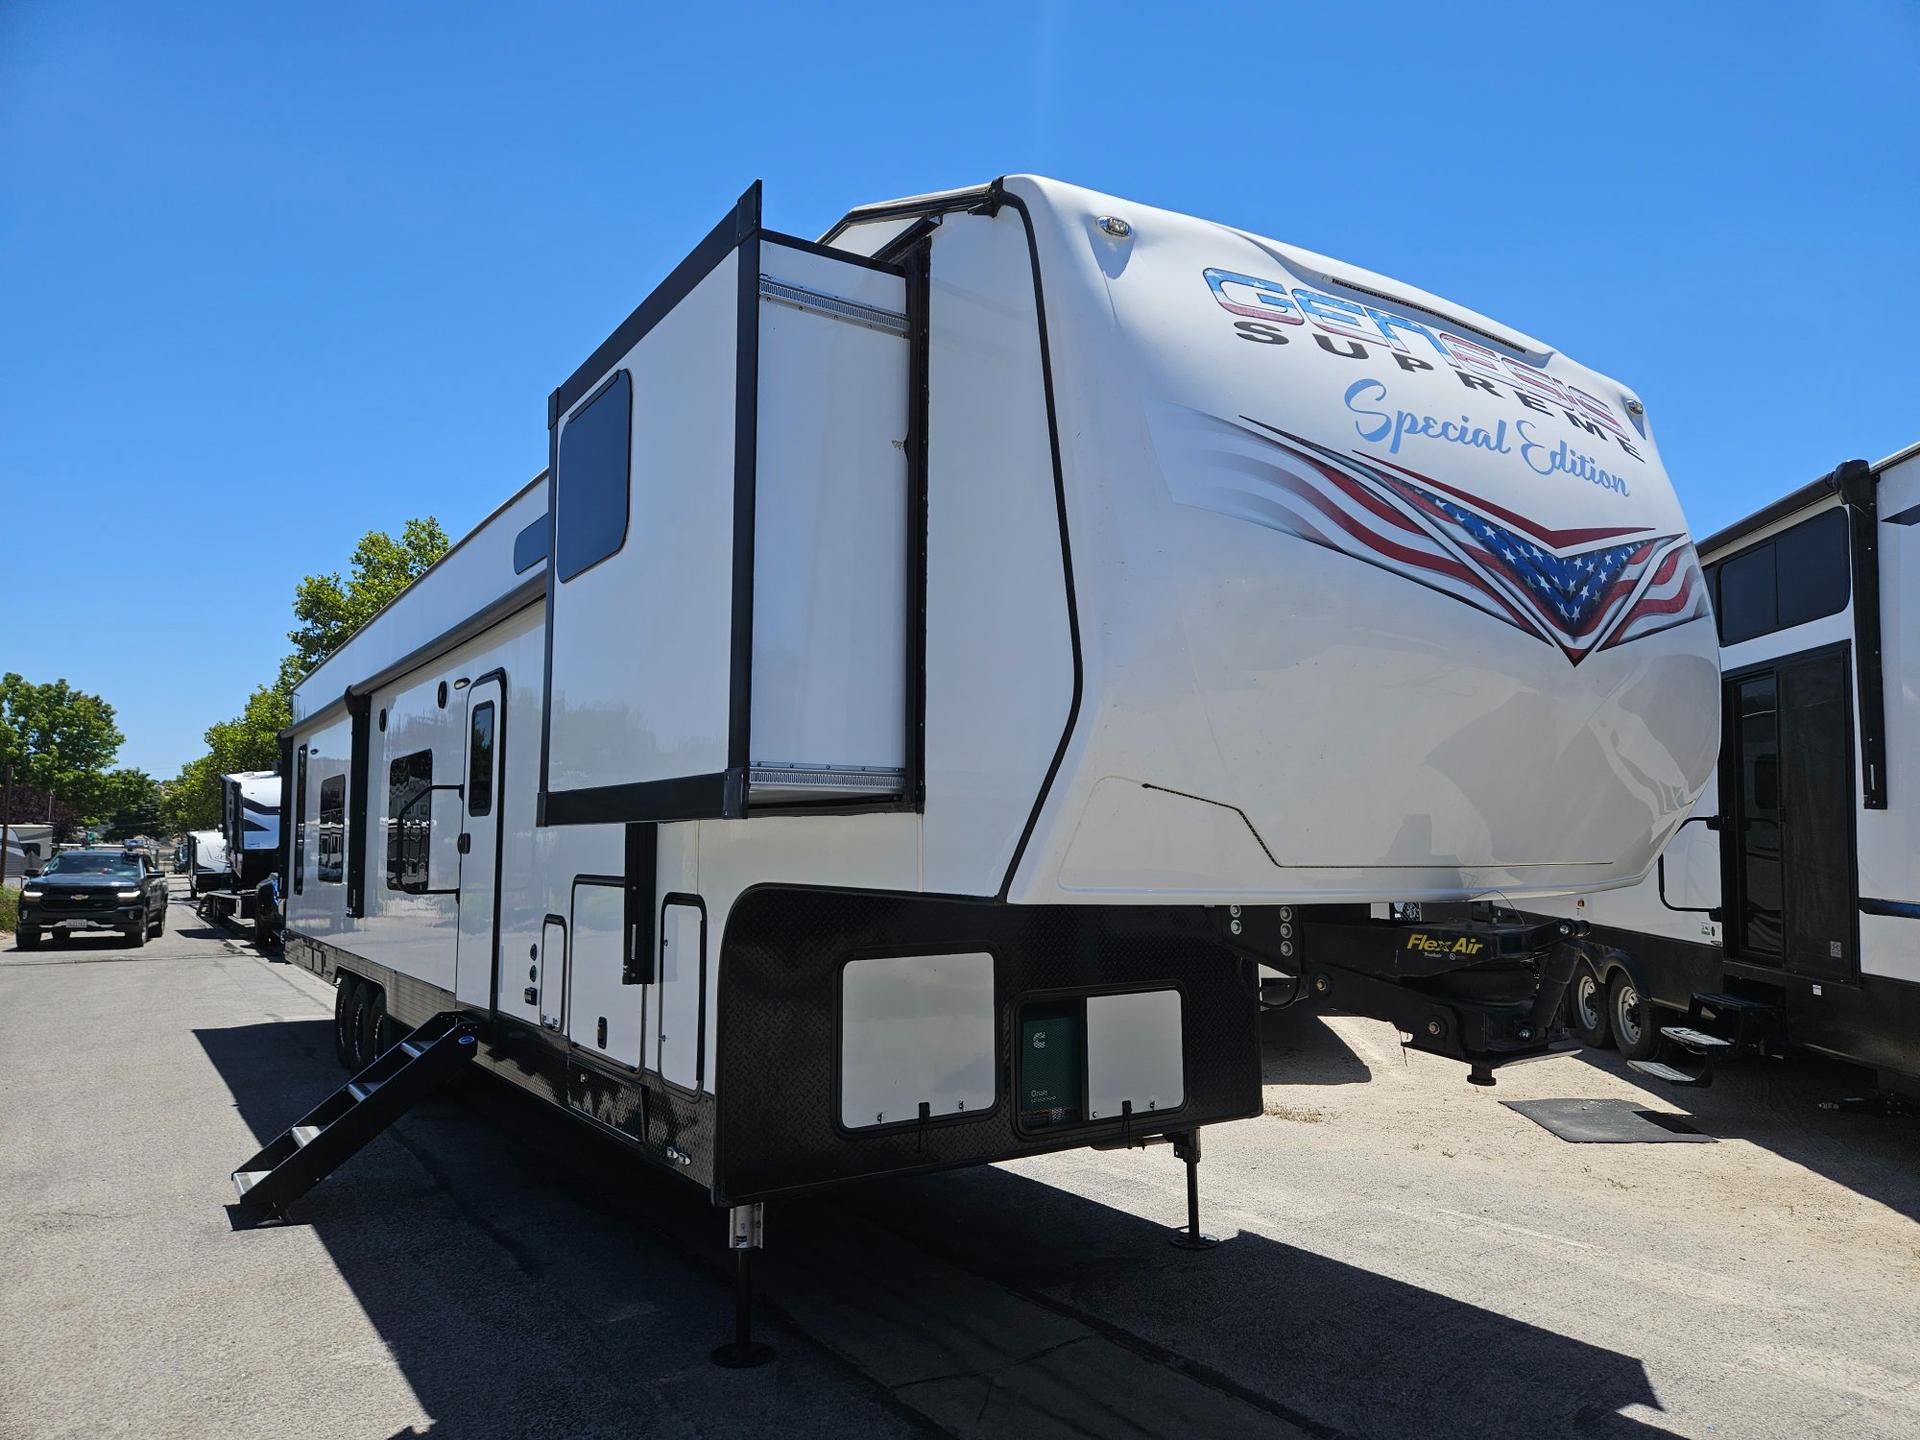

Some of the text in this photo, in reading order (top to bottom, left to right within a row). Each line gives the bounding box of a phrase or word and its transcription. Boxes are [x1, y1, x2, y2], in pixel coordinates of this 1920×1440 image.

[1202, 267, 1631, 440] GENESIS
[1233, 321, 1646, 464] SUPREME
[1343, 378, 1632, 498] Special Edition
